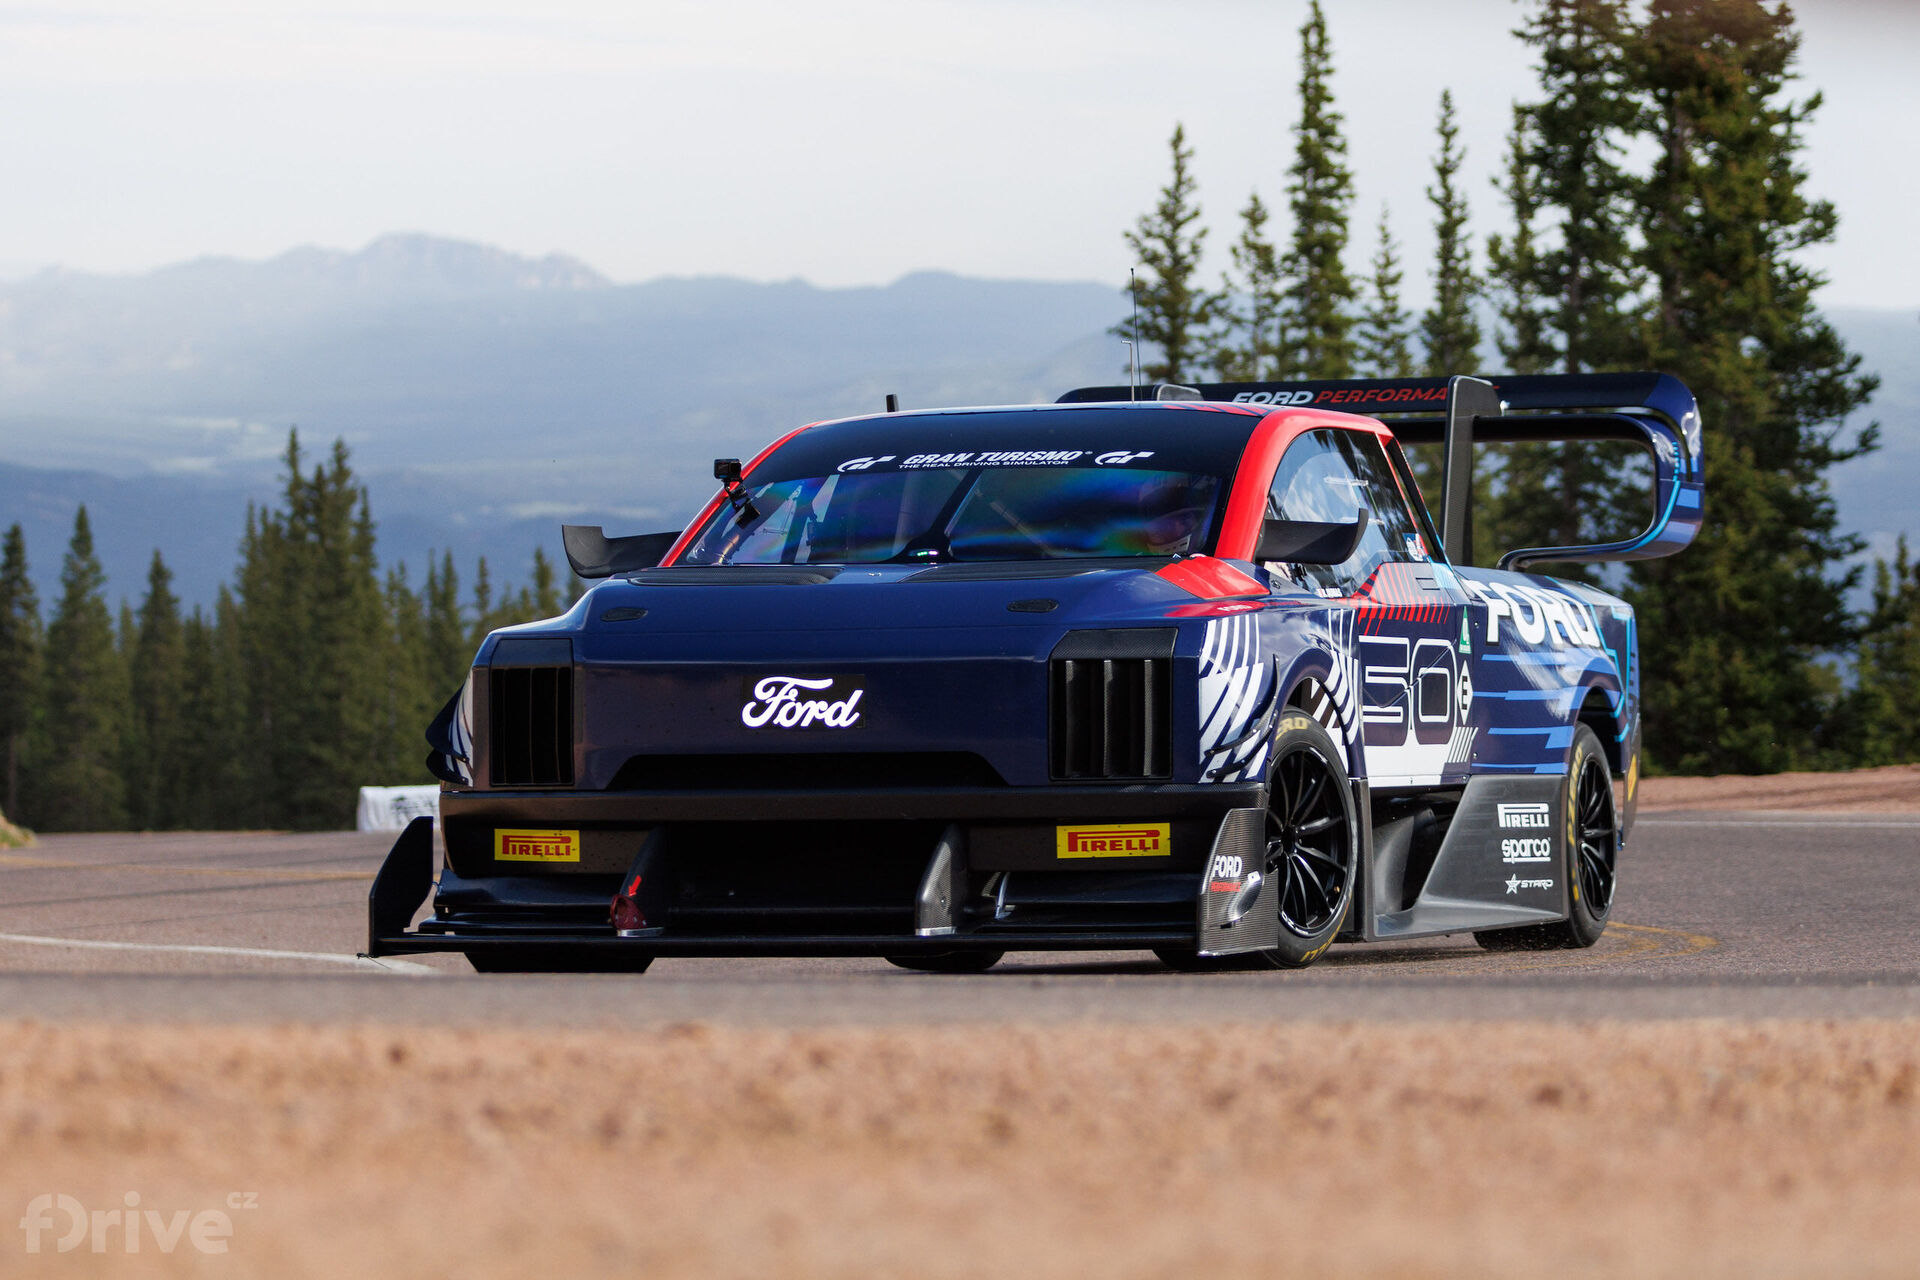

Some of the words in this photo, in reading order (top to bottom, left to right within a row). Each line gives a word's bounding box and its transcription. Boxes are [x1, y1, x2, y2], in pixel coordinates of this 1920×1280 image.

[1232, 390, 1314, 405] FORD
[1314, 385, 1499, 404] PERFORMA
[903, 453, 975, 465] GRAN
[975, 450, 1083, 462] TURISMO
[1461, 578, 1600, 648] FORD
[741, 676, 864, 728] Ford
[1358, 635, 1458, 747] 50
[1497, 803, 1550, 828] PIRELLI
[502, 835, 572, 856] PIRELLI
[1067, 830, 1161, 853] PIRELLI
[1501, 838, 1551, 864] sparco
[1211, 855, 1243, 878] FORD
